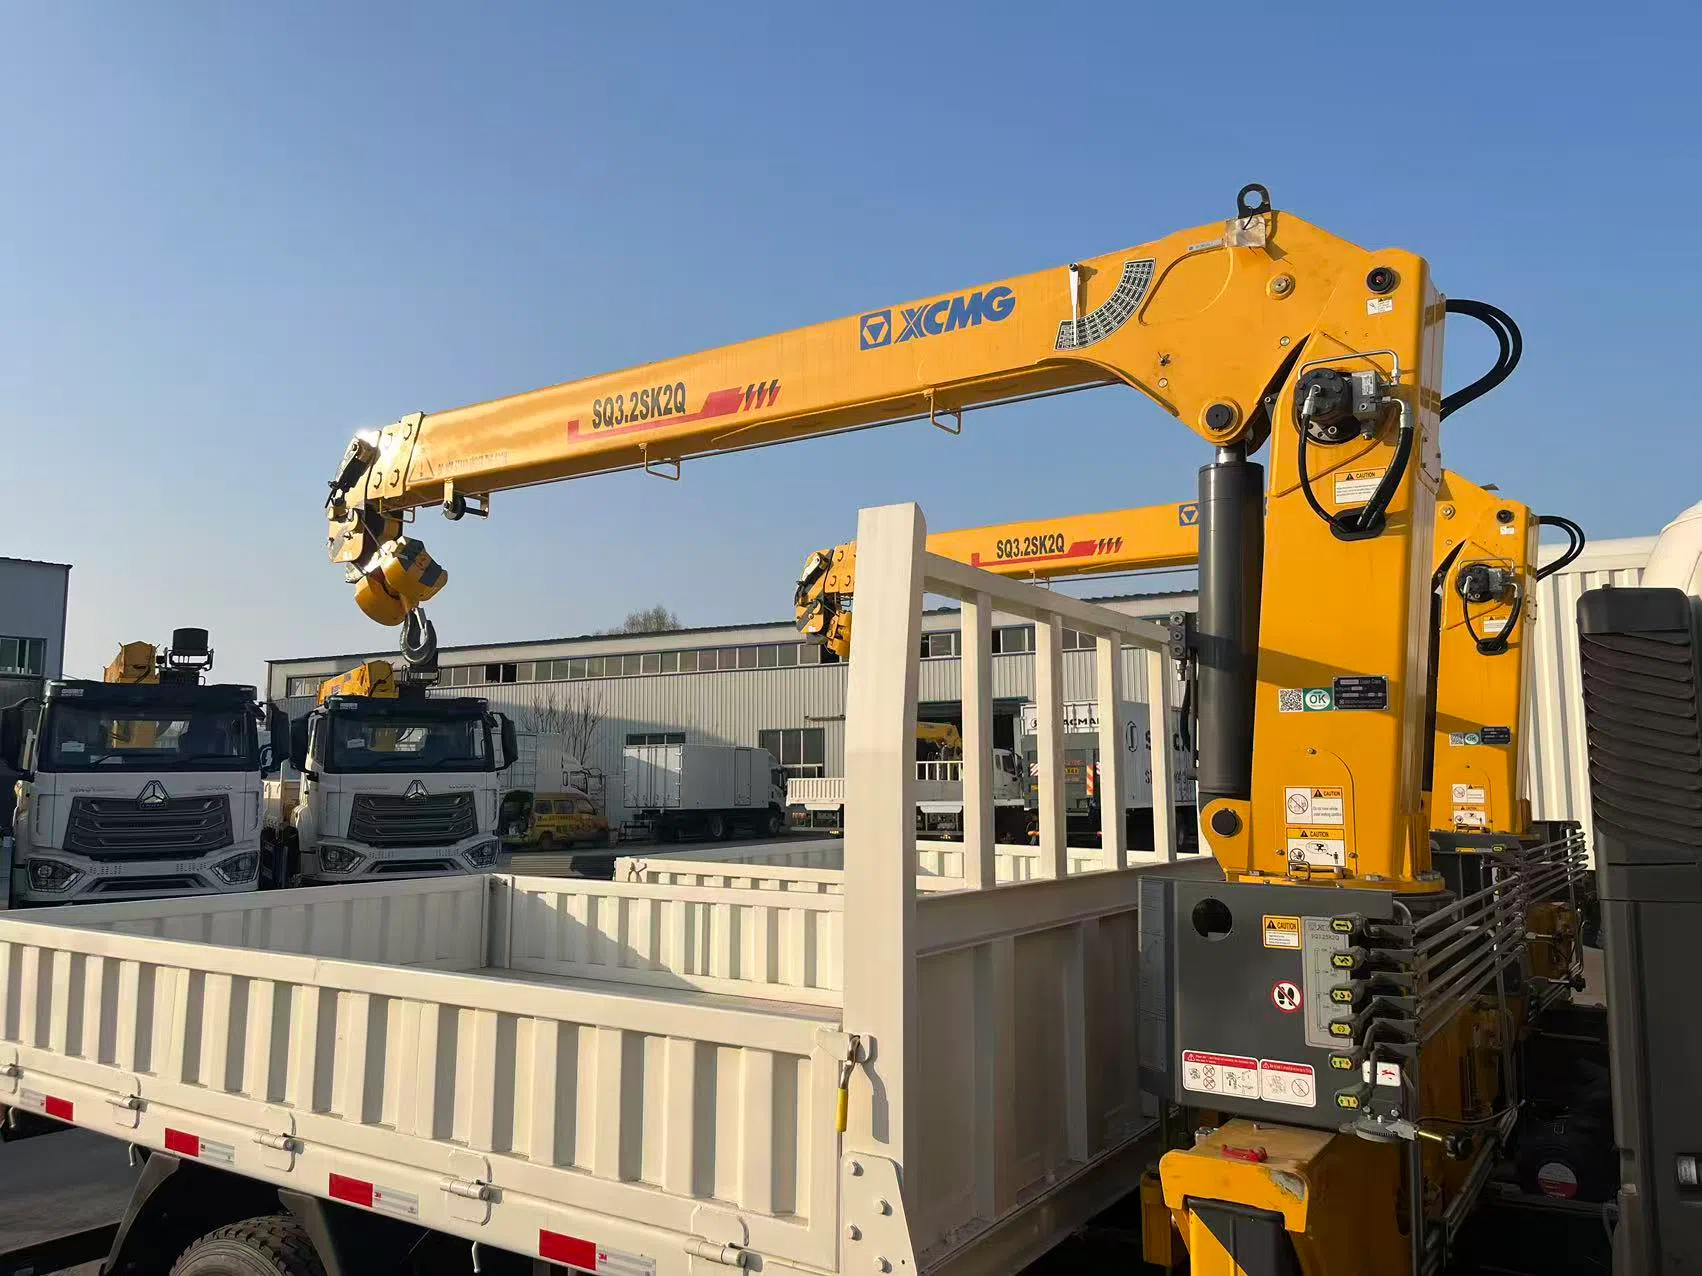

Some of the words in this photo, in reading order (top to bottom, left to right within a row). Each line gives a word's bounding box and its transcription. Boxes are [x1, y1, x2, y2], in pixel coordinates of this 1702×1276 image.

[894, 286, 1016, 344] XCMG
[592, 381, 686, 429] SQ3.2SK2Q
[996, 533, 1065, 559] SQ3.2SK2Q
[1309, 694, 1327, 704] OK
[1276, 921, 1297, 930] CAUTION
